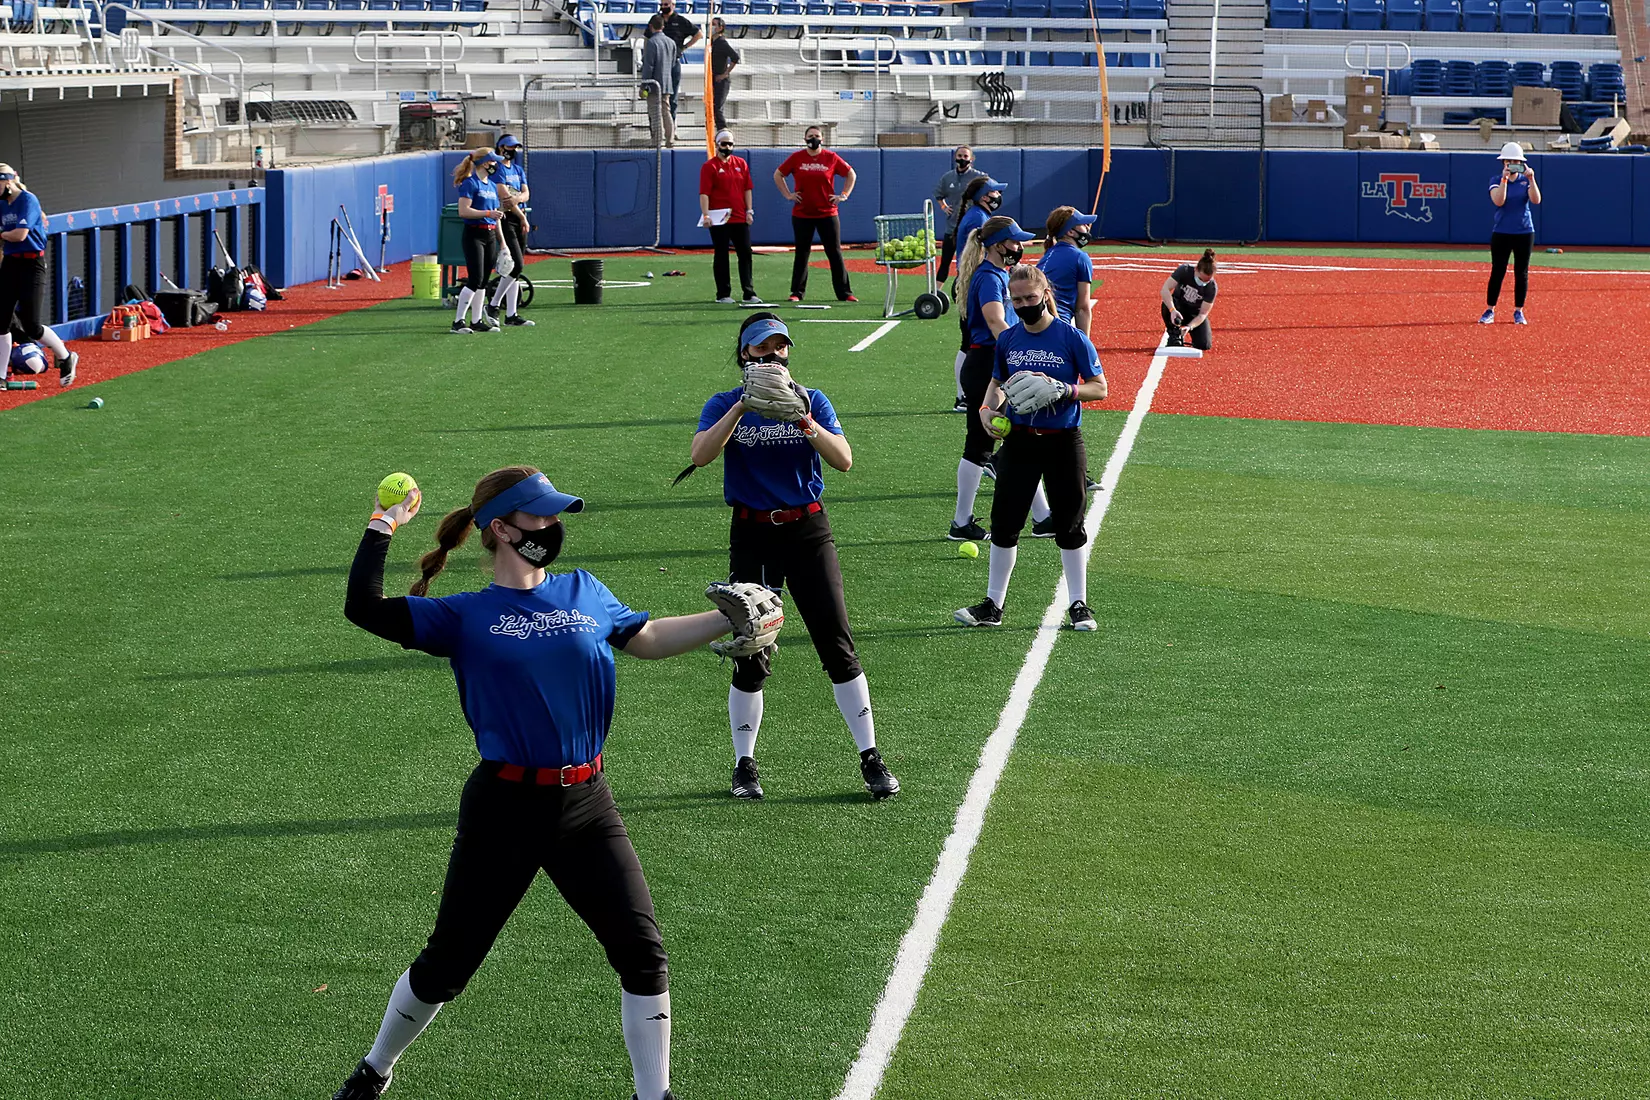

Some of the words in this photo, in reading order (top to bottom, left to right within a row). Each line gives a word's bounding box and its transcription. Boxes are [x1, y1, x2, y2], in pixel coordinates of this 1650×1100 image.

[733, 424, 760, 447] Lady
[489, 614, 534, 640] Lady
[537, 626, 597, 638] SOFTBALL
